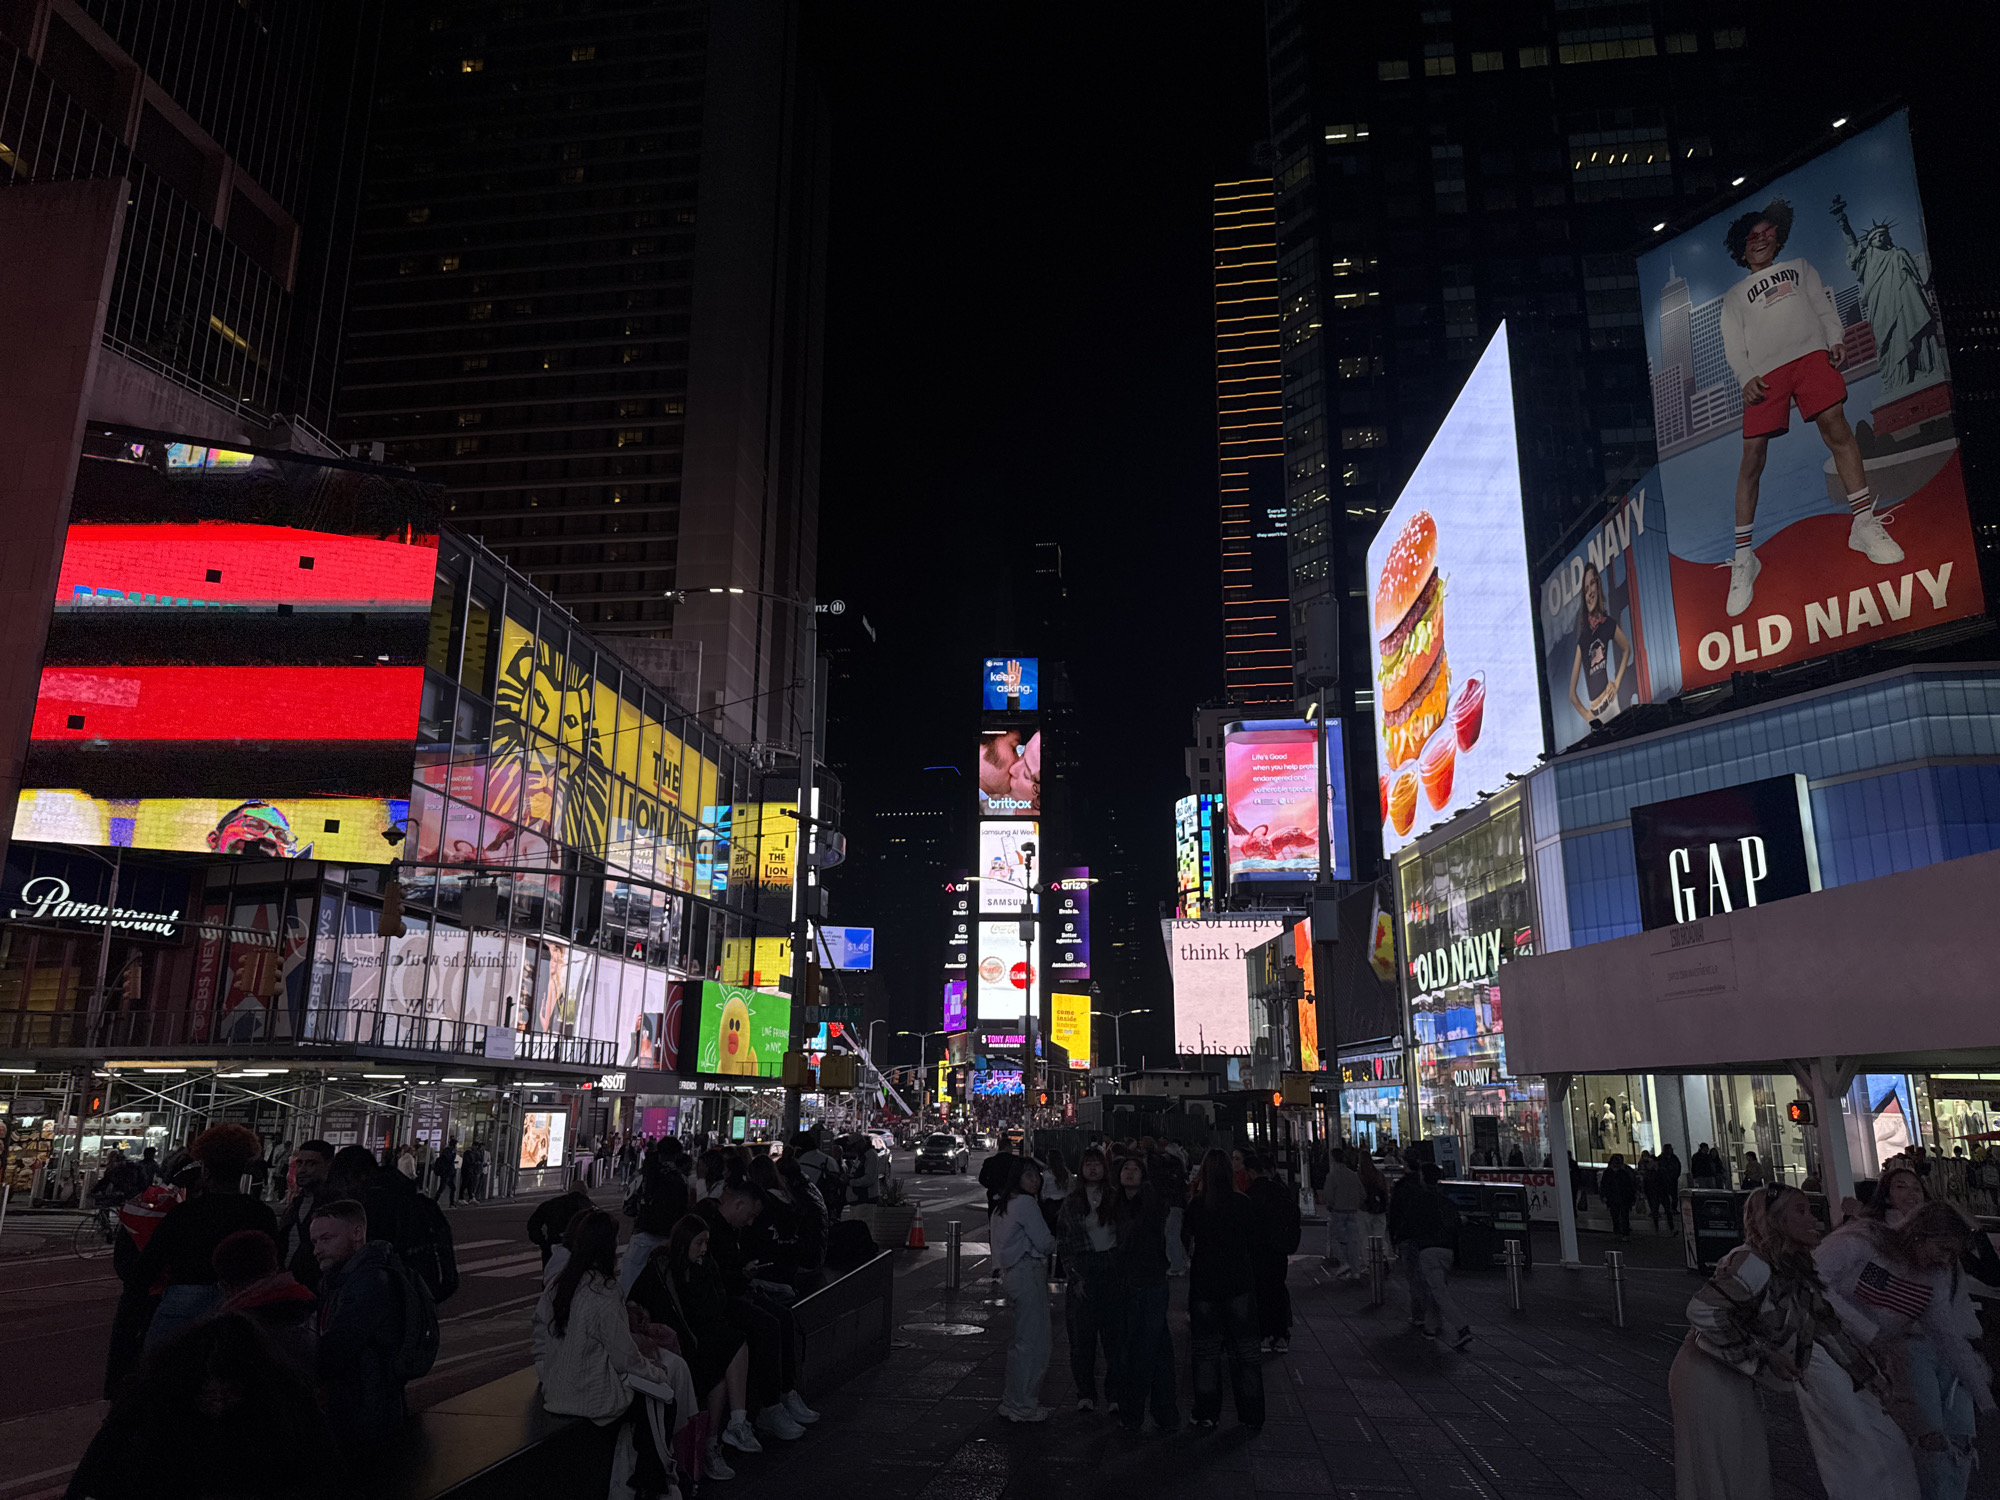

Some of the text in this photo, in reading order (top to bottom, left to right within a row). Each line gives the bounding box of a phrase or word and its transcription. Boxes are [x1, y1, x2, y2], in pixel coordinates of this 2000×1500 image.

[1747, 278, 1769, 304] OLD
[1770, 269, 1799, 287] NAVY
[1547, 488, 1645, 617] OLD NAVY
[1698, 562, 1954, 671] OLD NAVY
[991, 672, 1016, 685] keep
[997, 683, 1032, 694] asking.
[653, 750, 681, 794] THE
[989, 797, 1032, 809] britbox
[981, 830, 1011, 838] Samsung
[769, 853, 786, 861] THE
[765, 864, 788, 878] LION
[761, 880, 792, 892] KING
[1061, 882, 1088, 890] arize
[1669, 836, 1768, 924] GAP
[21, 876, 180, 937] Paramount
[311, 908, 333, 1010] CBS NEWS
[1181, 943, 1231, 961] think
[1417, 928, 1503, 992] OLD NAVY
[834, 1007, 849, 1021] 44
[981, 1035, 987, 1044] 5
[987, 1035, 1005, 1044] TONY
[1454, 1067, 1491, 1087] OLD NAVY
